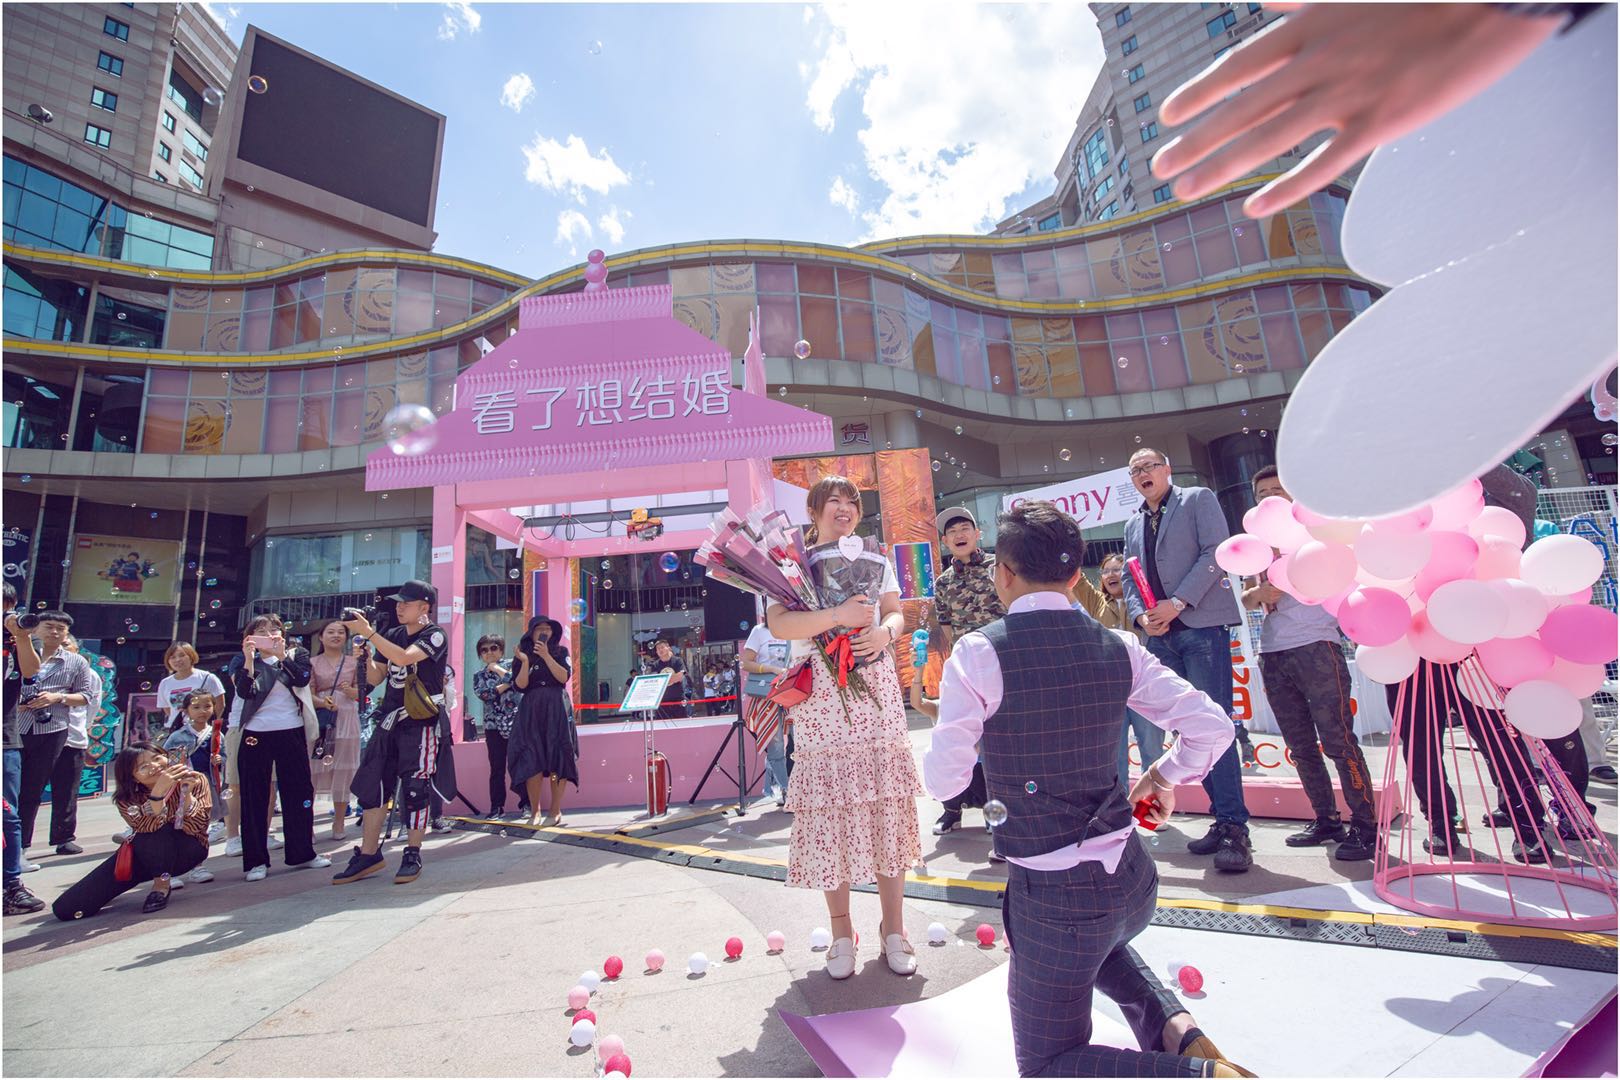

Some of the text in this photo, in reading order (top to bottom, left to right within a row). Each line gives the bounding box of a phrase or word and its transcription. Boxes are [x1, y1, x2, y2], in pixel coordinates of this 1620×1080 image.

[471, 369, 733, 435] 看了想结婚
[841, 422, 870, 446] 货
